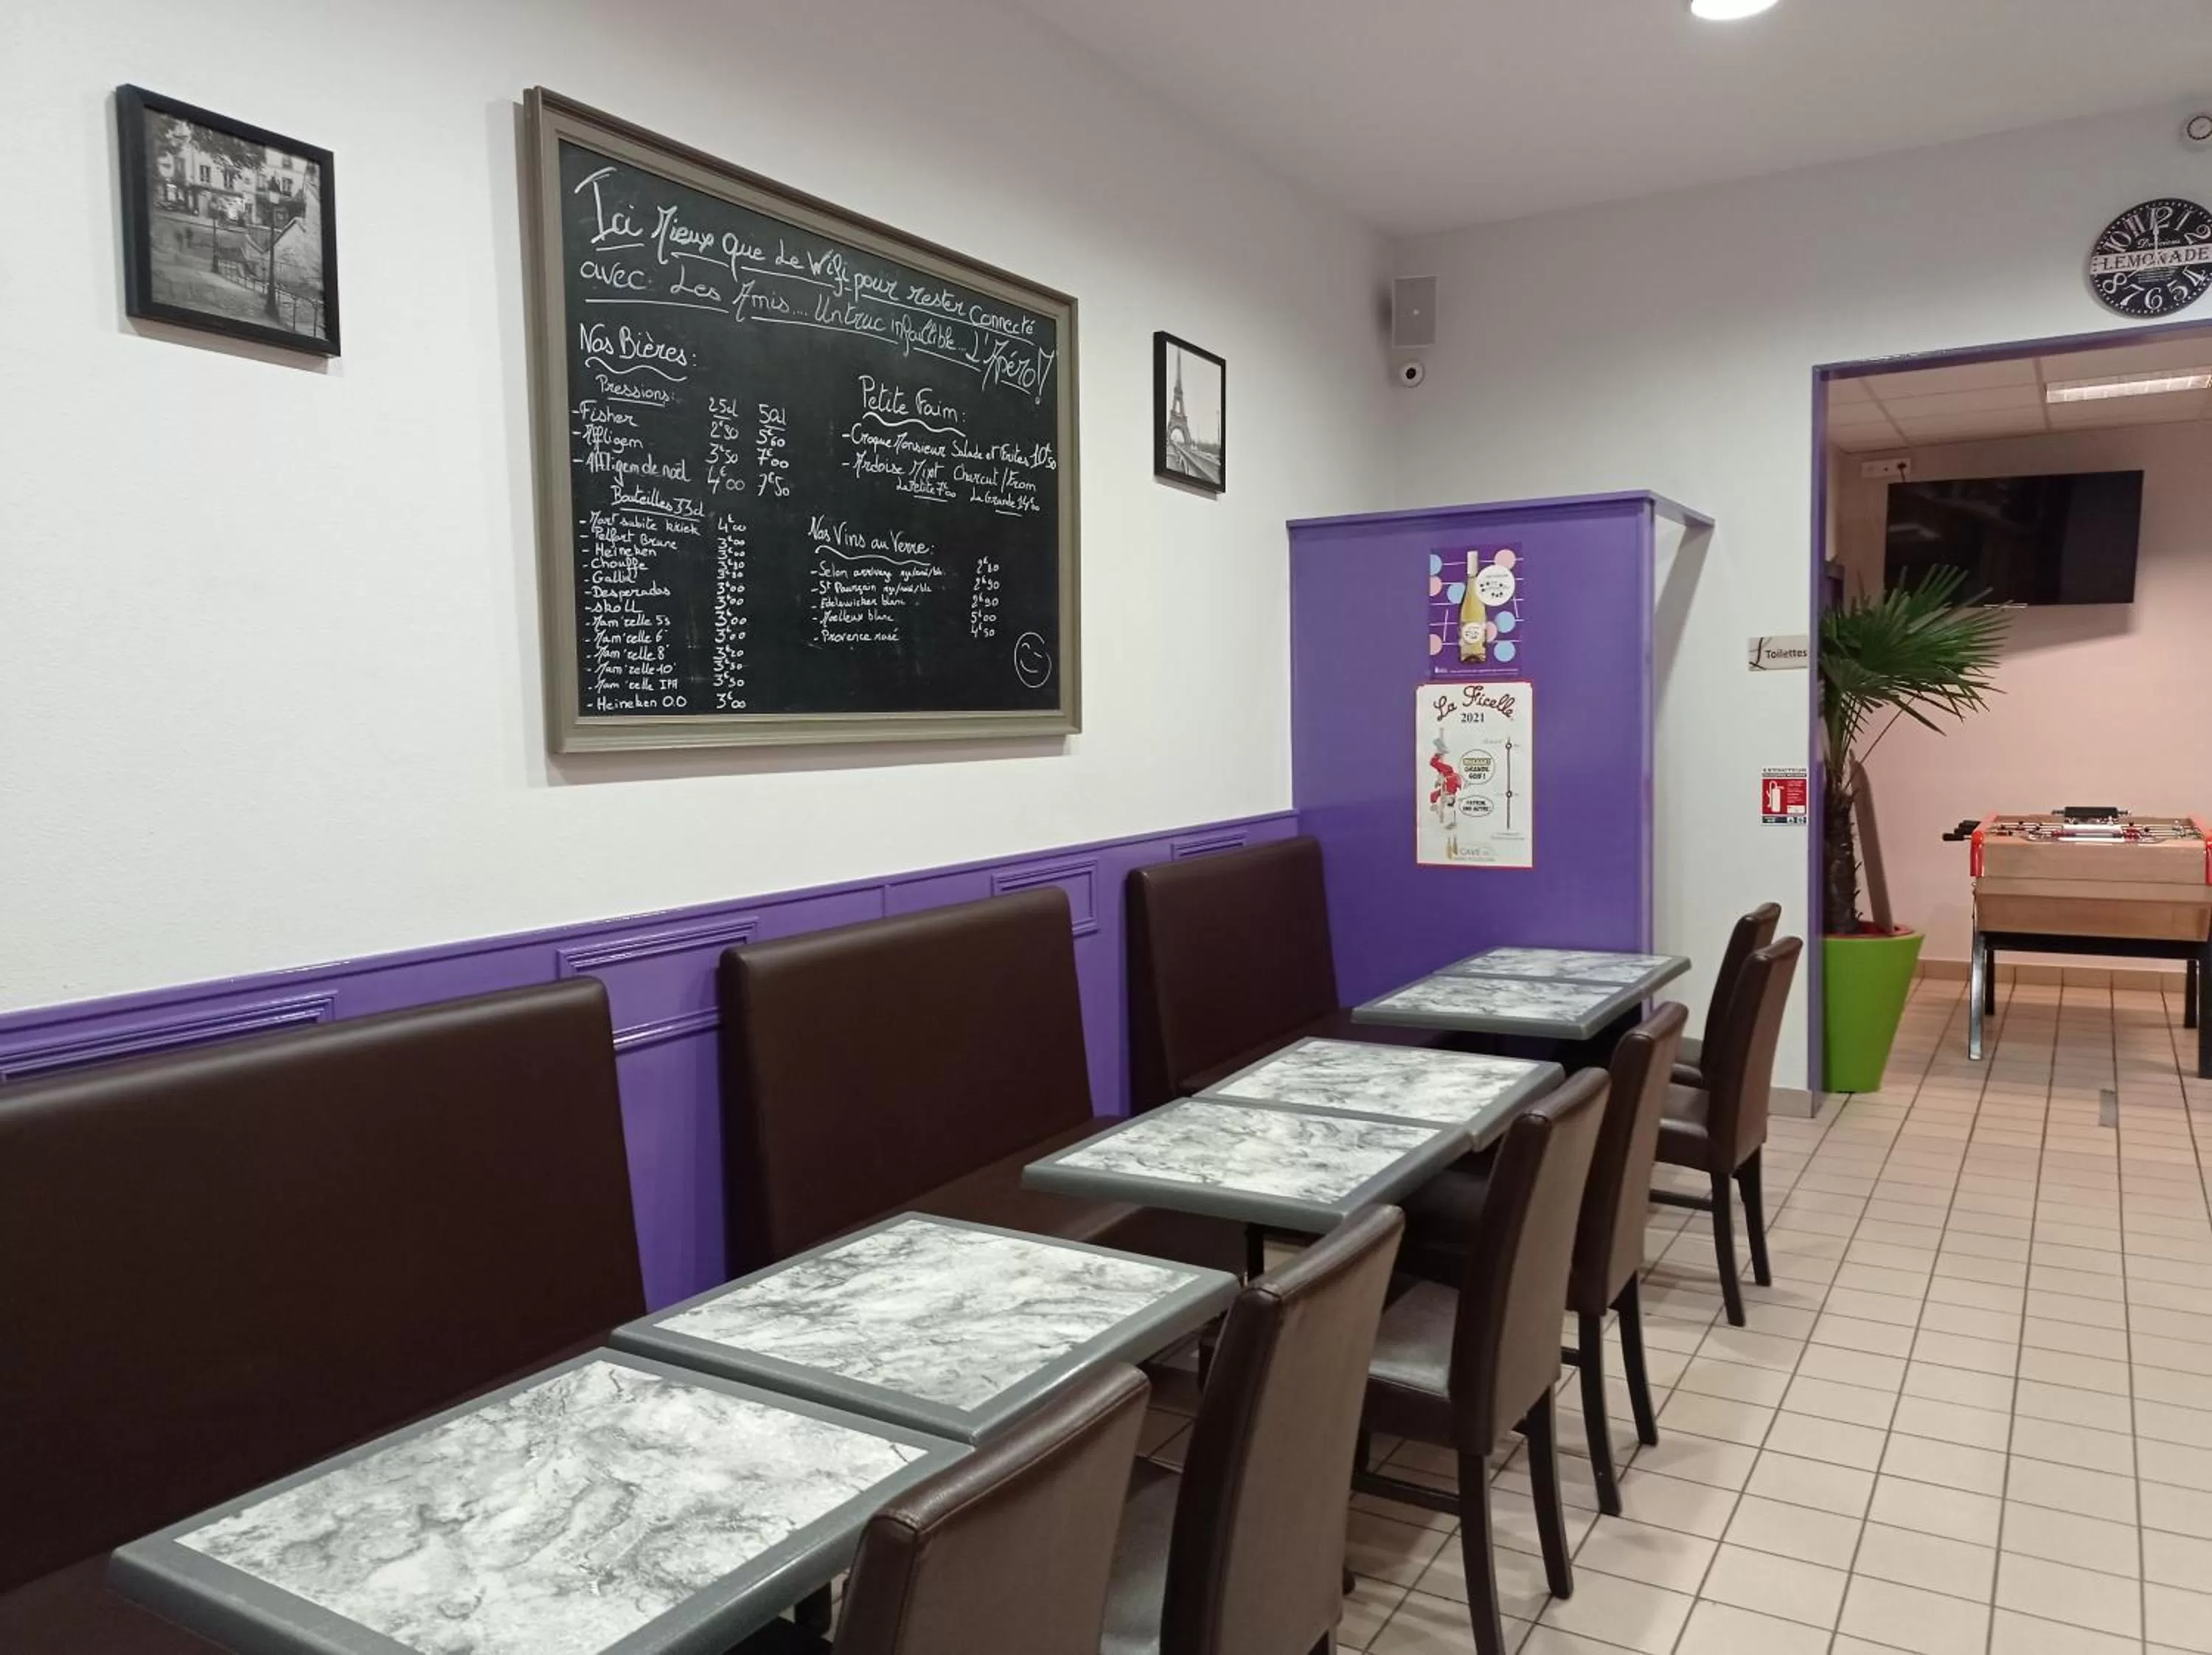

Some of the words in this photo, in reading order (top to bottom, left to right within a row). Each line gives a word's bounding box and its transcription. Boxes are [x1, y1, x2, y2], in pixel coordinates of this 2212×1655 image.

[2149, 206, 2174, 231] 12
[2174, 209, 2196, 232] 1
[575, 167, 644, 244] Ici
[651, 205, 714, 265] Mieux
[854, 272, 900, 301] pour
[906, 285, 966, 316] rester
[2102, 231, 2132, 252] 10
[2183, 223, 2212, 245] 2
[580, 260, 648, 291] avec
[2102, 272, 2128, 294] 8
[2120, 283, 2146, 306] 7
[2144, 287, 2163, 310] 6
[2166, 280, 2188, 302] 5
[580, 323, 615, 356] Nos
[858, 375, 909, 415] Petite
[807, 515, 830, 542] Nos
[833, 521, 866, 548] Vins
[871, 540, 889, 551] au
[1433, 695, 1457, 722] La
[1462, 684, 1516, 718] Ficelle
[1460, 712, 1485, 724] 2021
